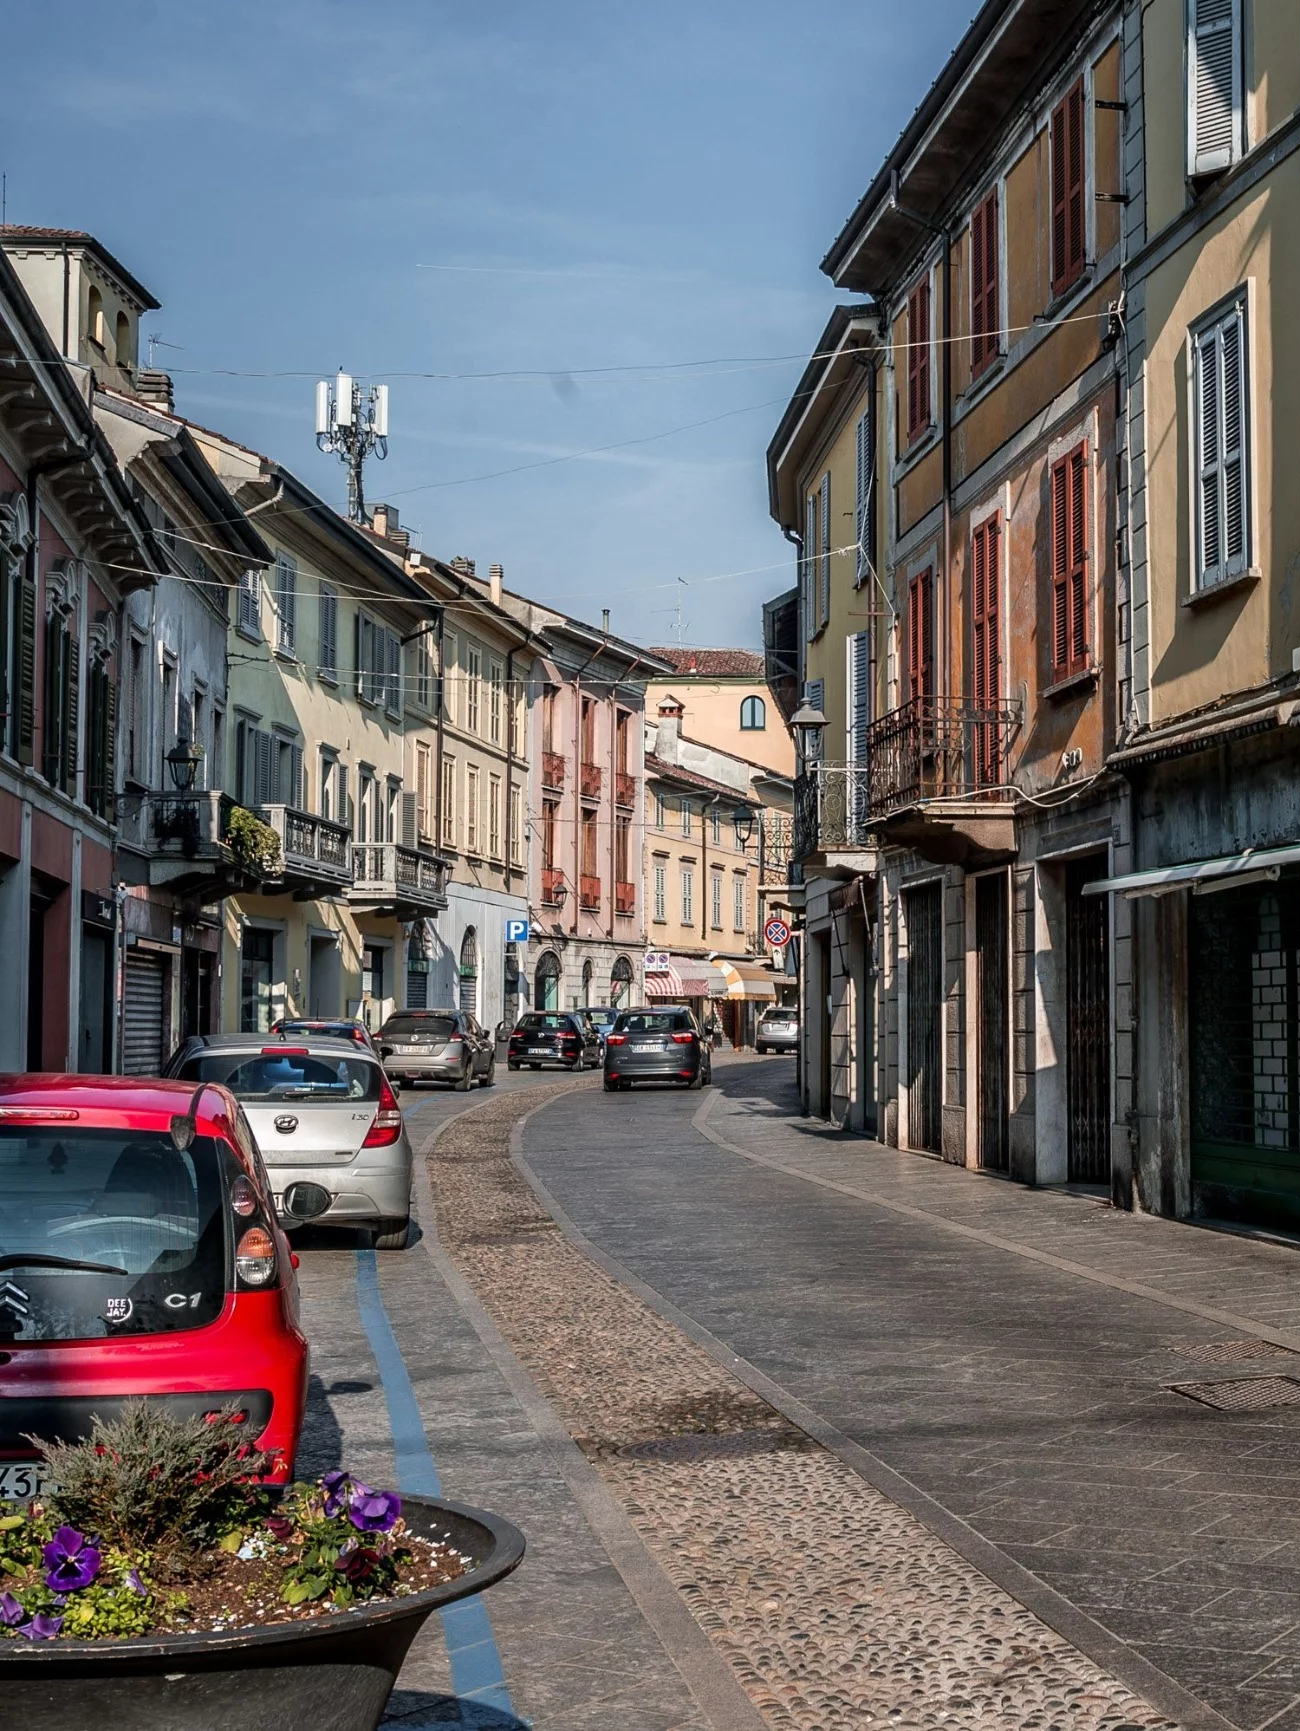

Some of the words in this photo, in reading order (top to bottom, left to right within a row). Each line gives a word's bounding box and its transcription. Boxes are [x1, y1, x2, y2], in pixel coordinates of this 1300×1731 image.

[510, 921, 525, 940] P
[107, 1298, 126, 1308] DEE
[164, 1292, 202, 1308] C1
